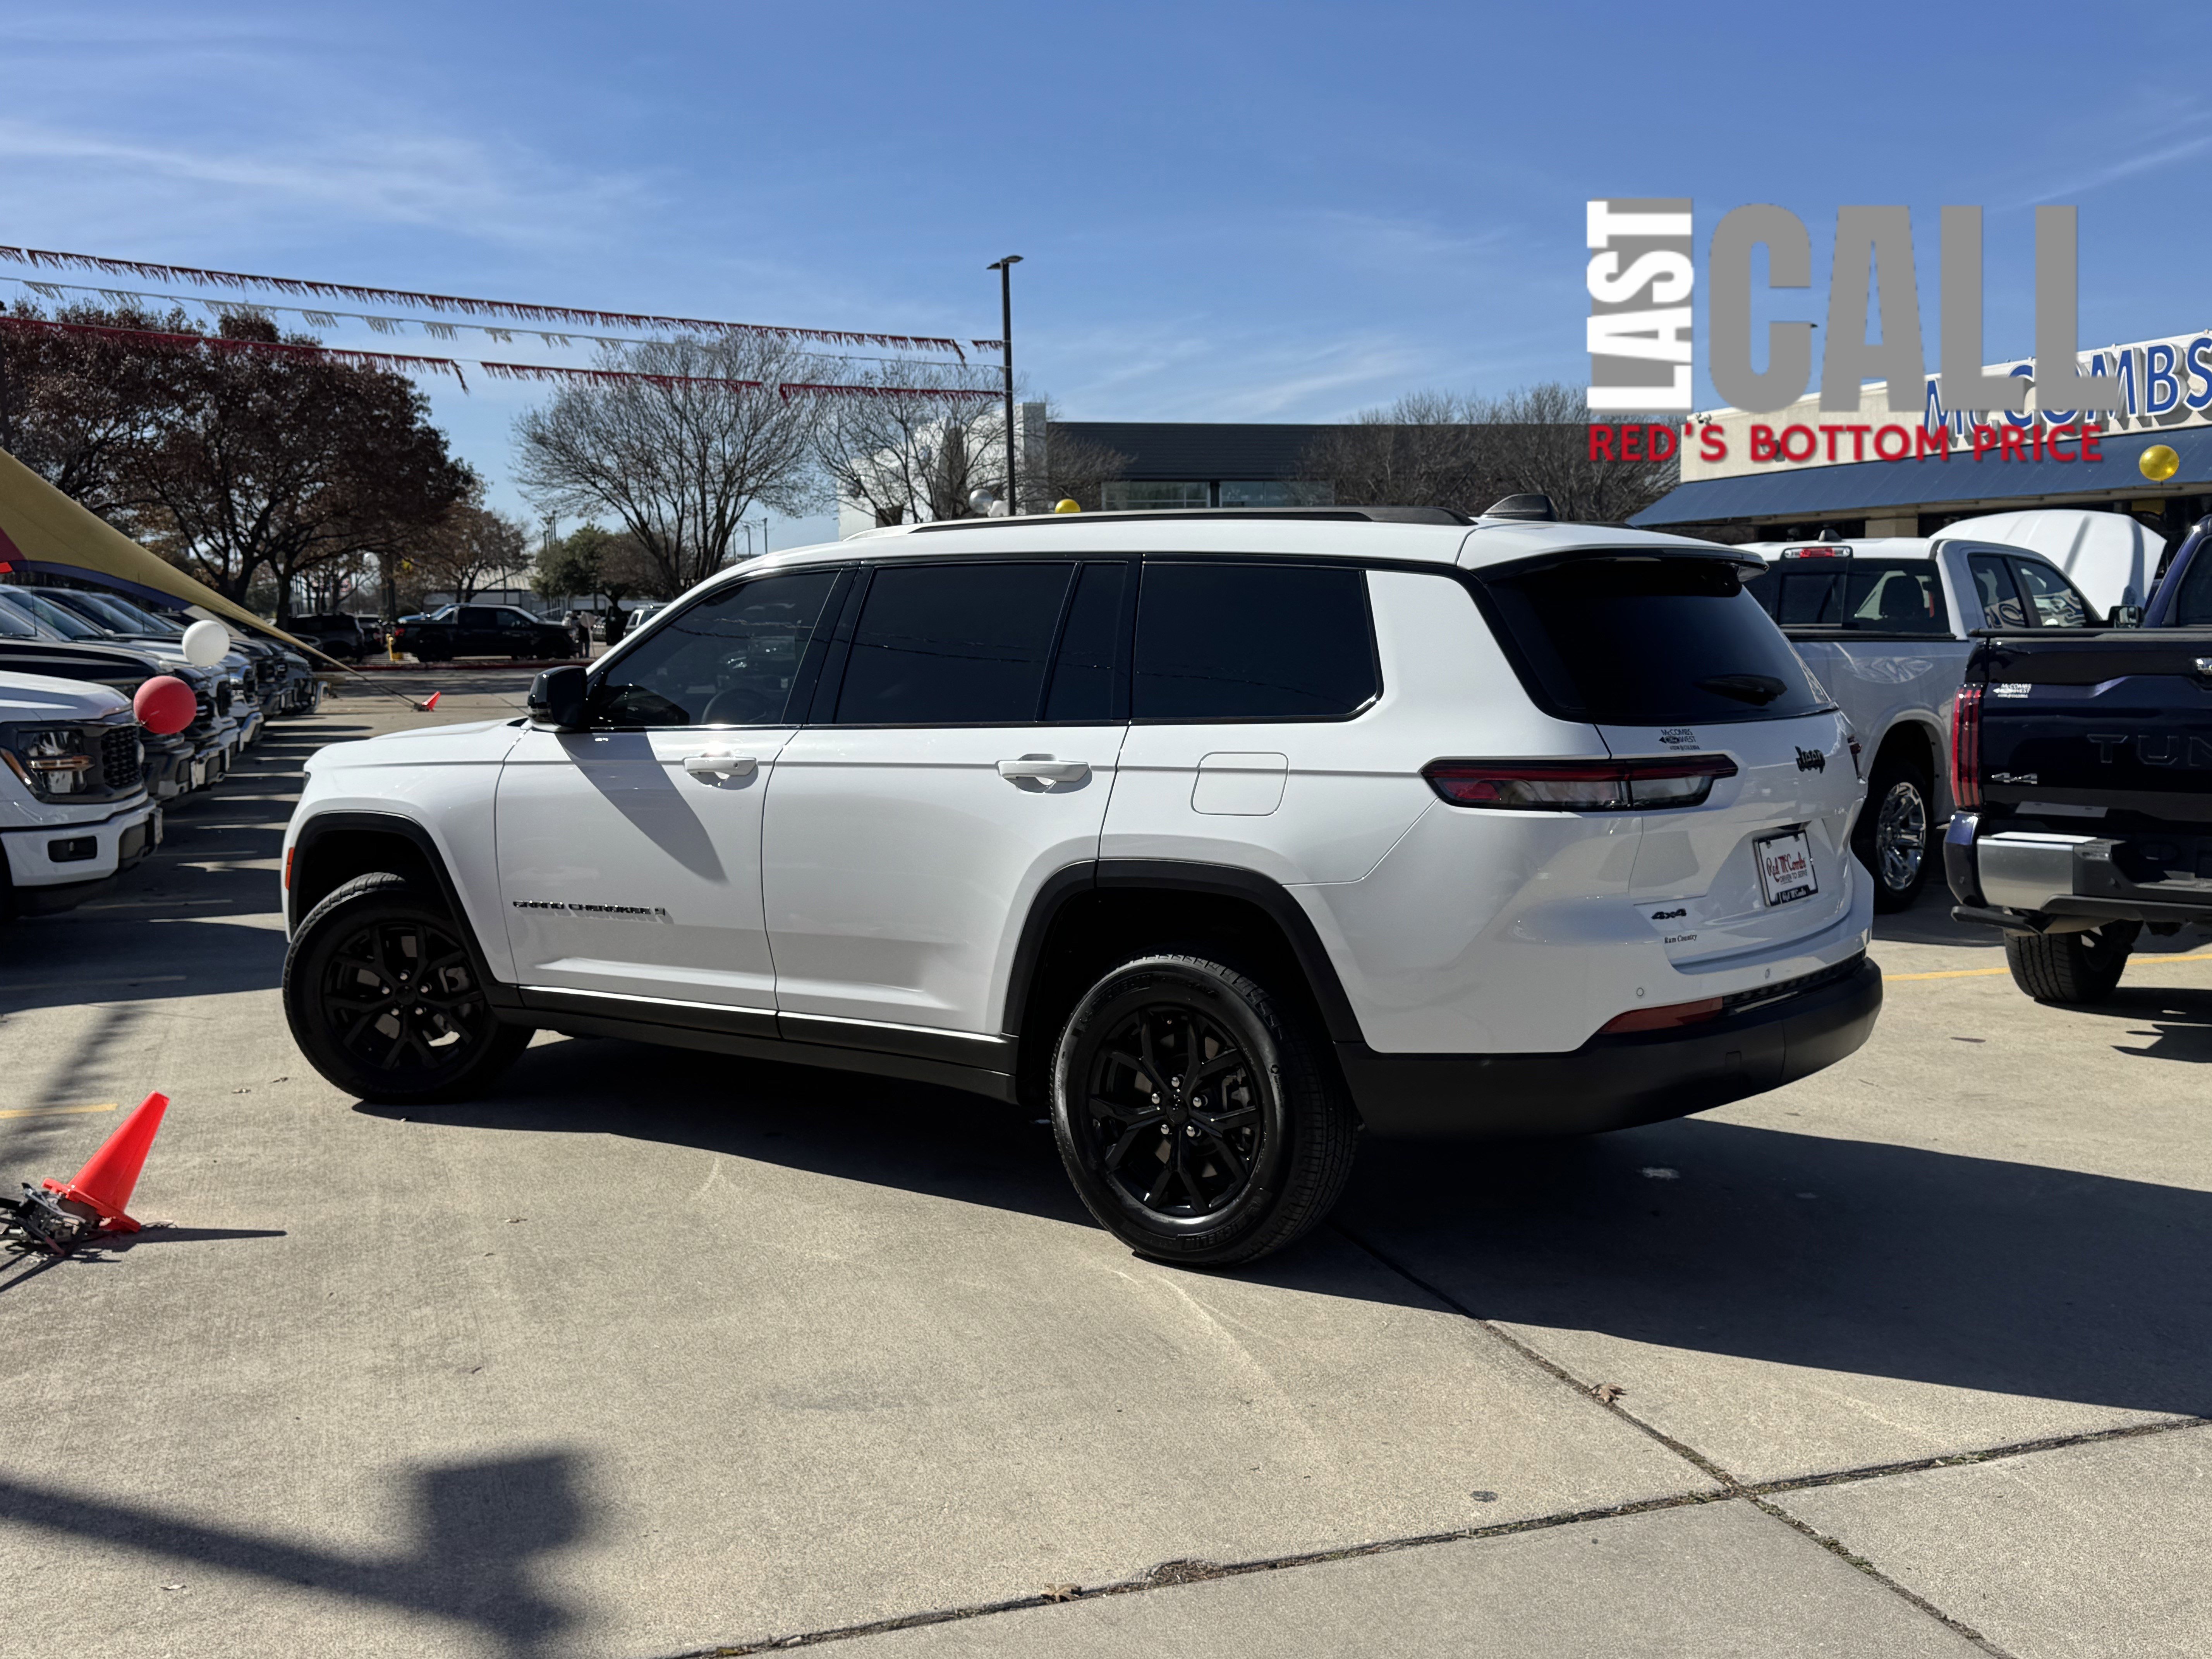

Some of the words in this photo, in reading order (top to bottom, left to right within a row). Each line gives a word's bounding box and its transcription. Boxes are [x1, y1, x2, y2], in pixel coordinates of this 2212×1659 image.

[1795, 745, 1826, 774] Jeep
[513, 900, 564, 909] GRAND
[568, 903, 651, 915] CHEROKEE
